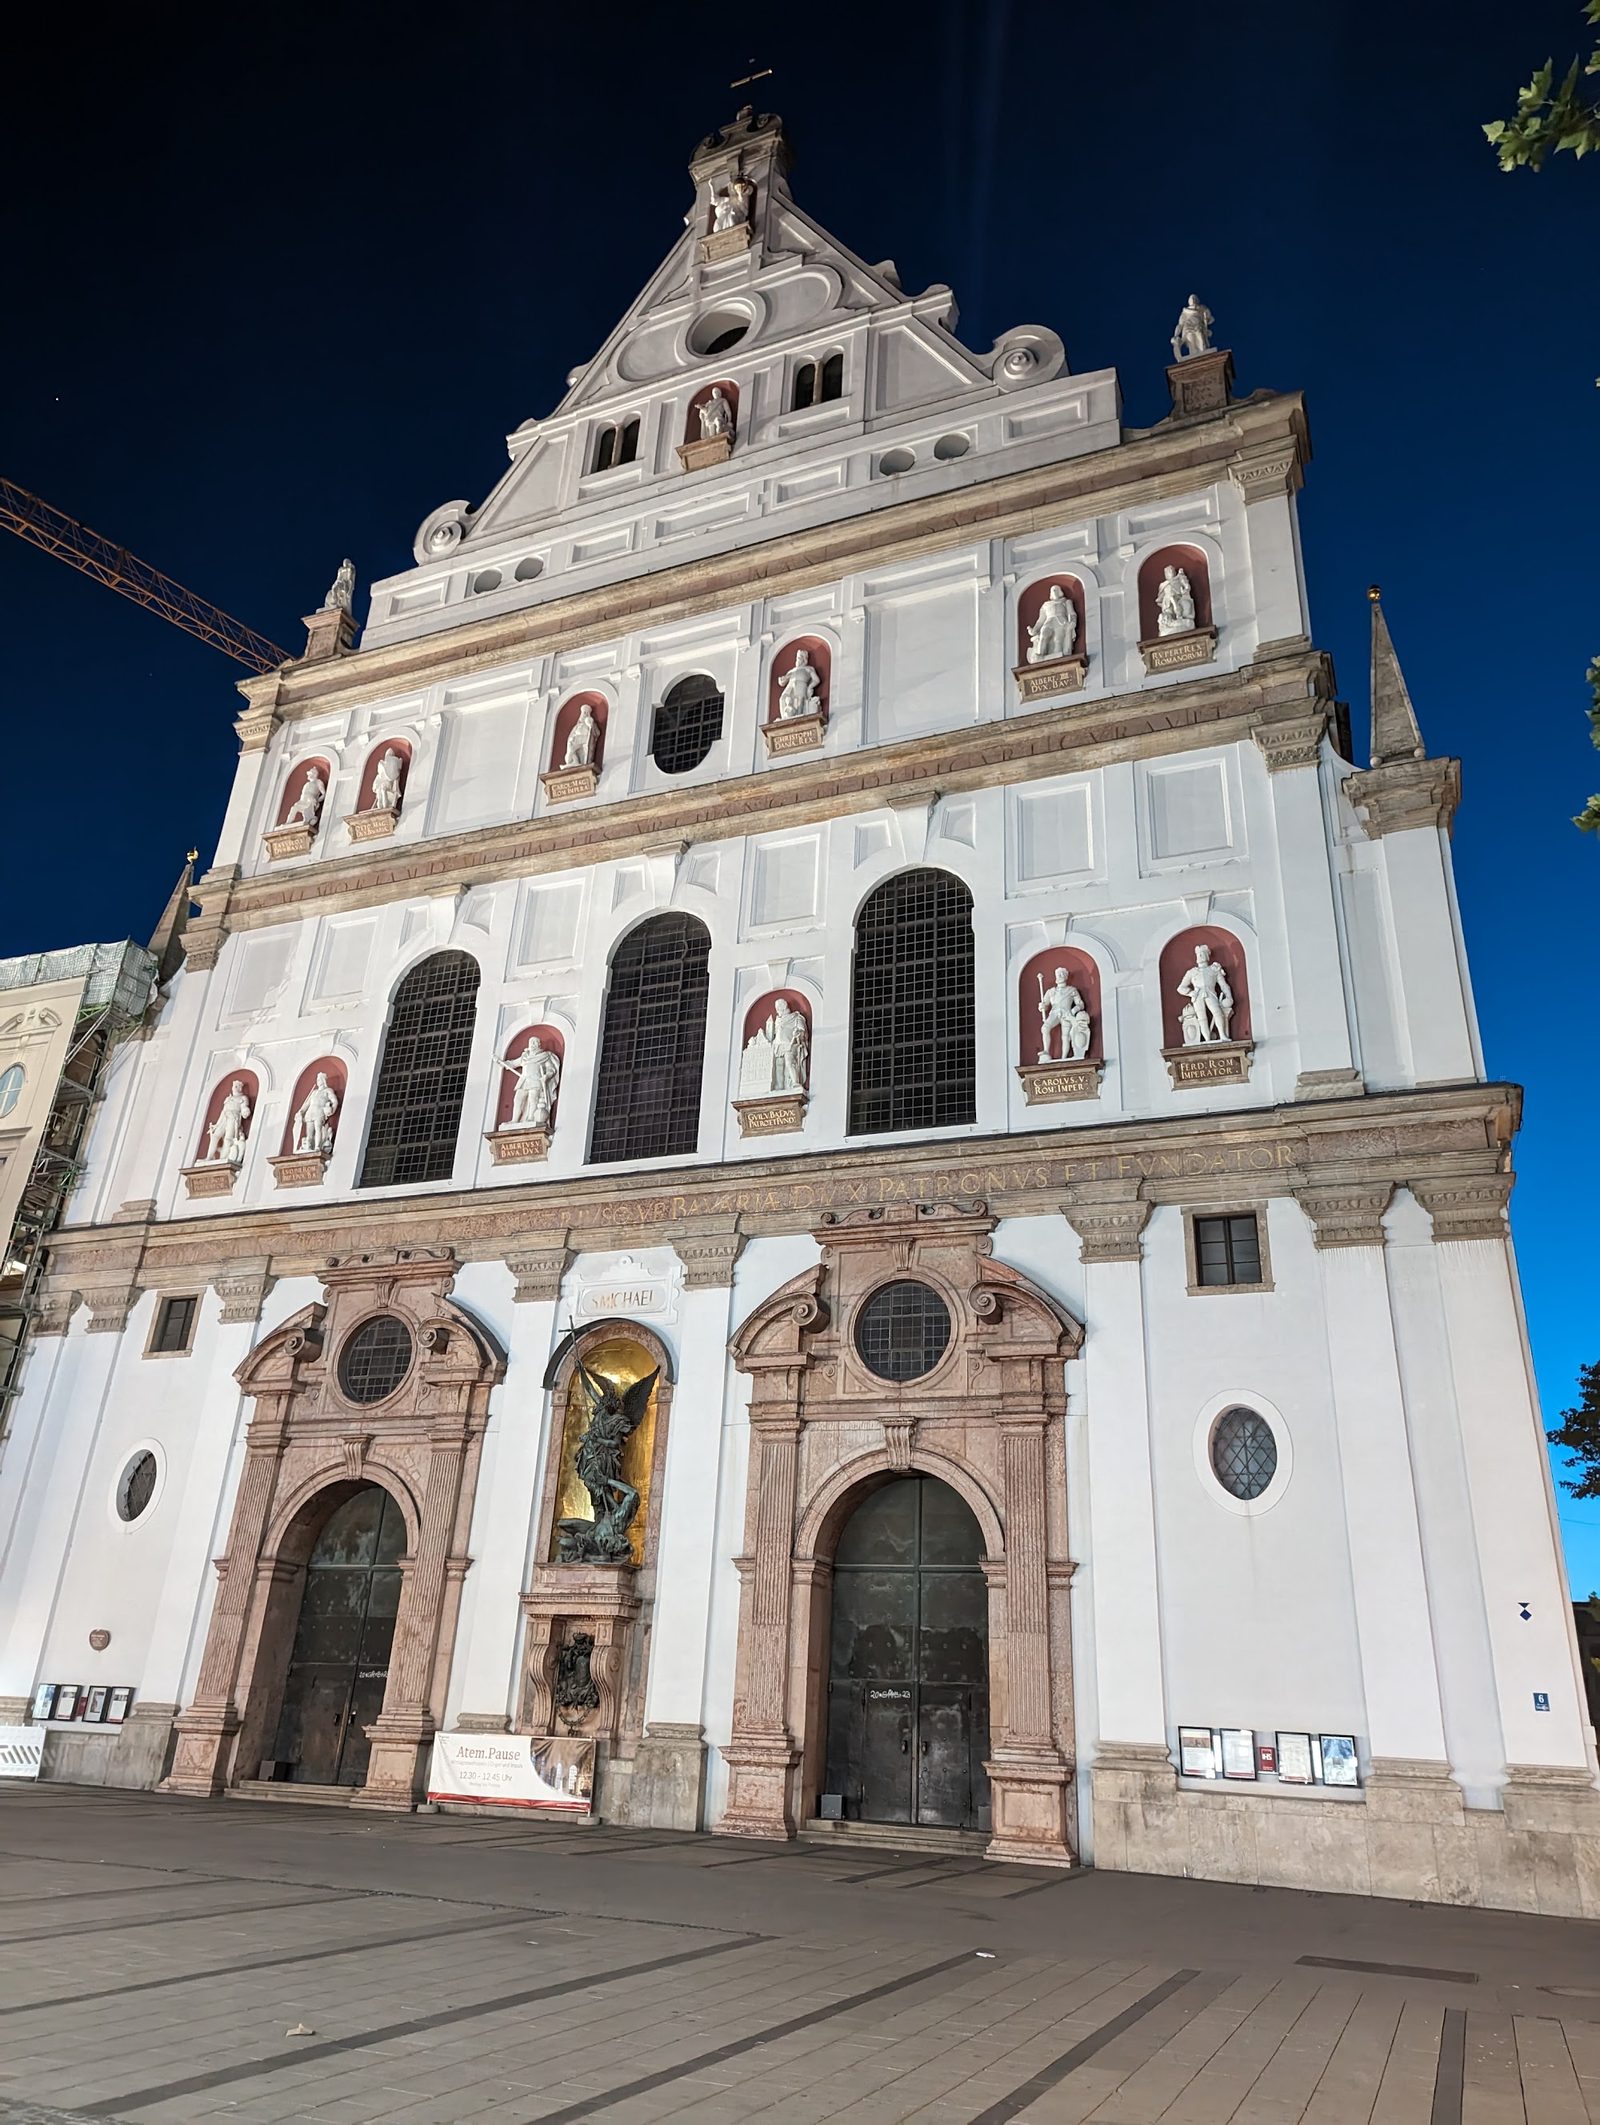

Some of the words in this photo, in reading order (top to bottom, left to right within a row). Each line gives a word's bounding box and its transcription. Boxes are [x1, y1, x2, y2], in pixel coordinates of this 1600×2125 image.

[878, 1167, 1048, 1201] PATRONVS
[1064, 1162, 1104, 1183] ET
[1116, 1145, 1298, 1179] FVNDATOR
[1538, 1694, 1545, 1703] 6
[456, 1746, 521, 1760] Atem.Pause
